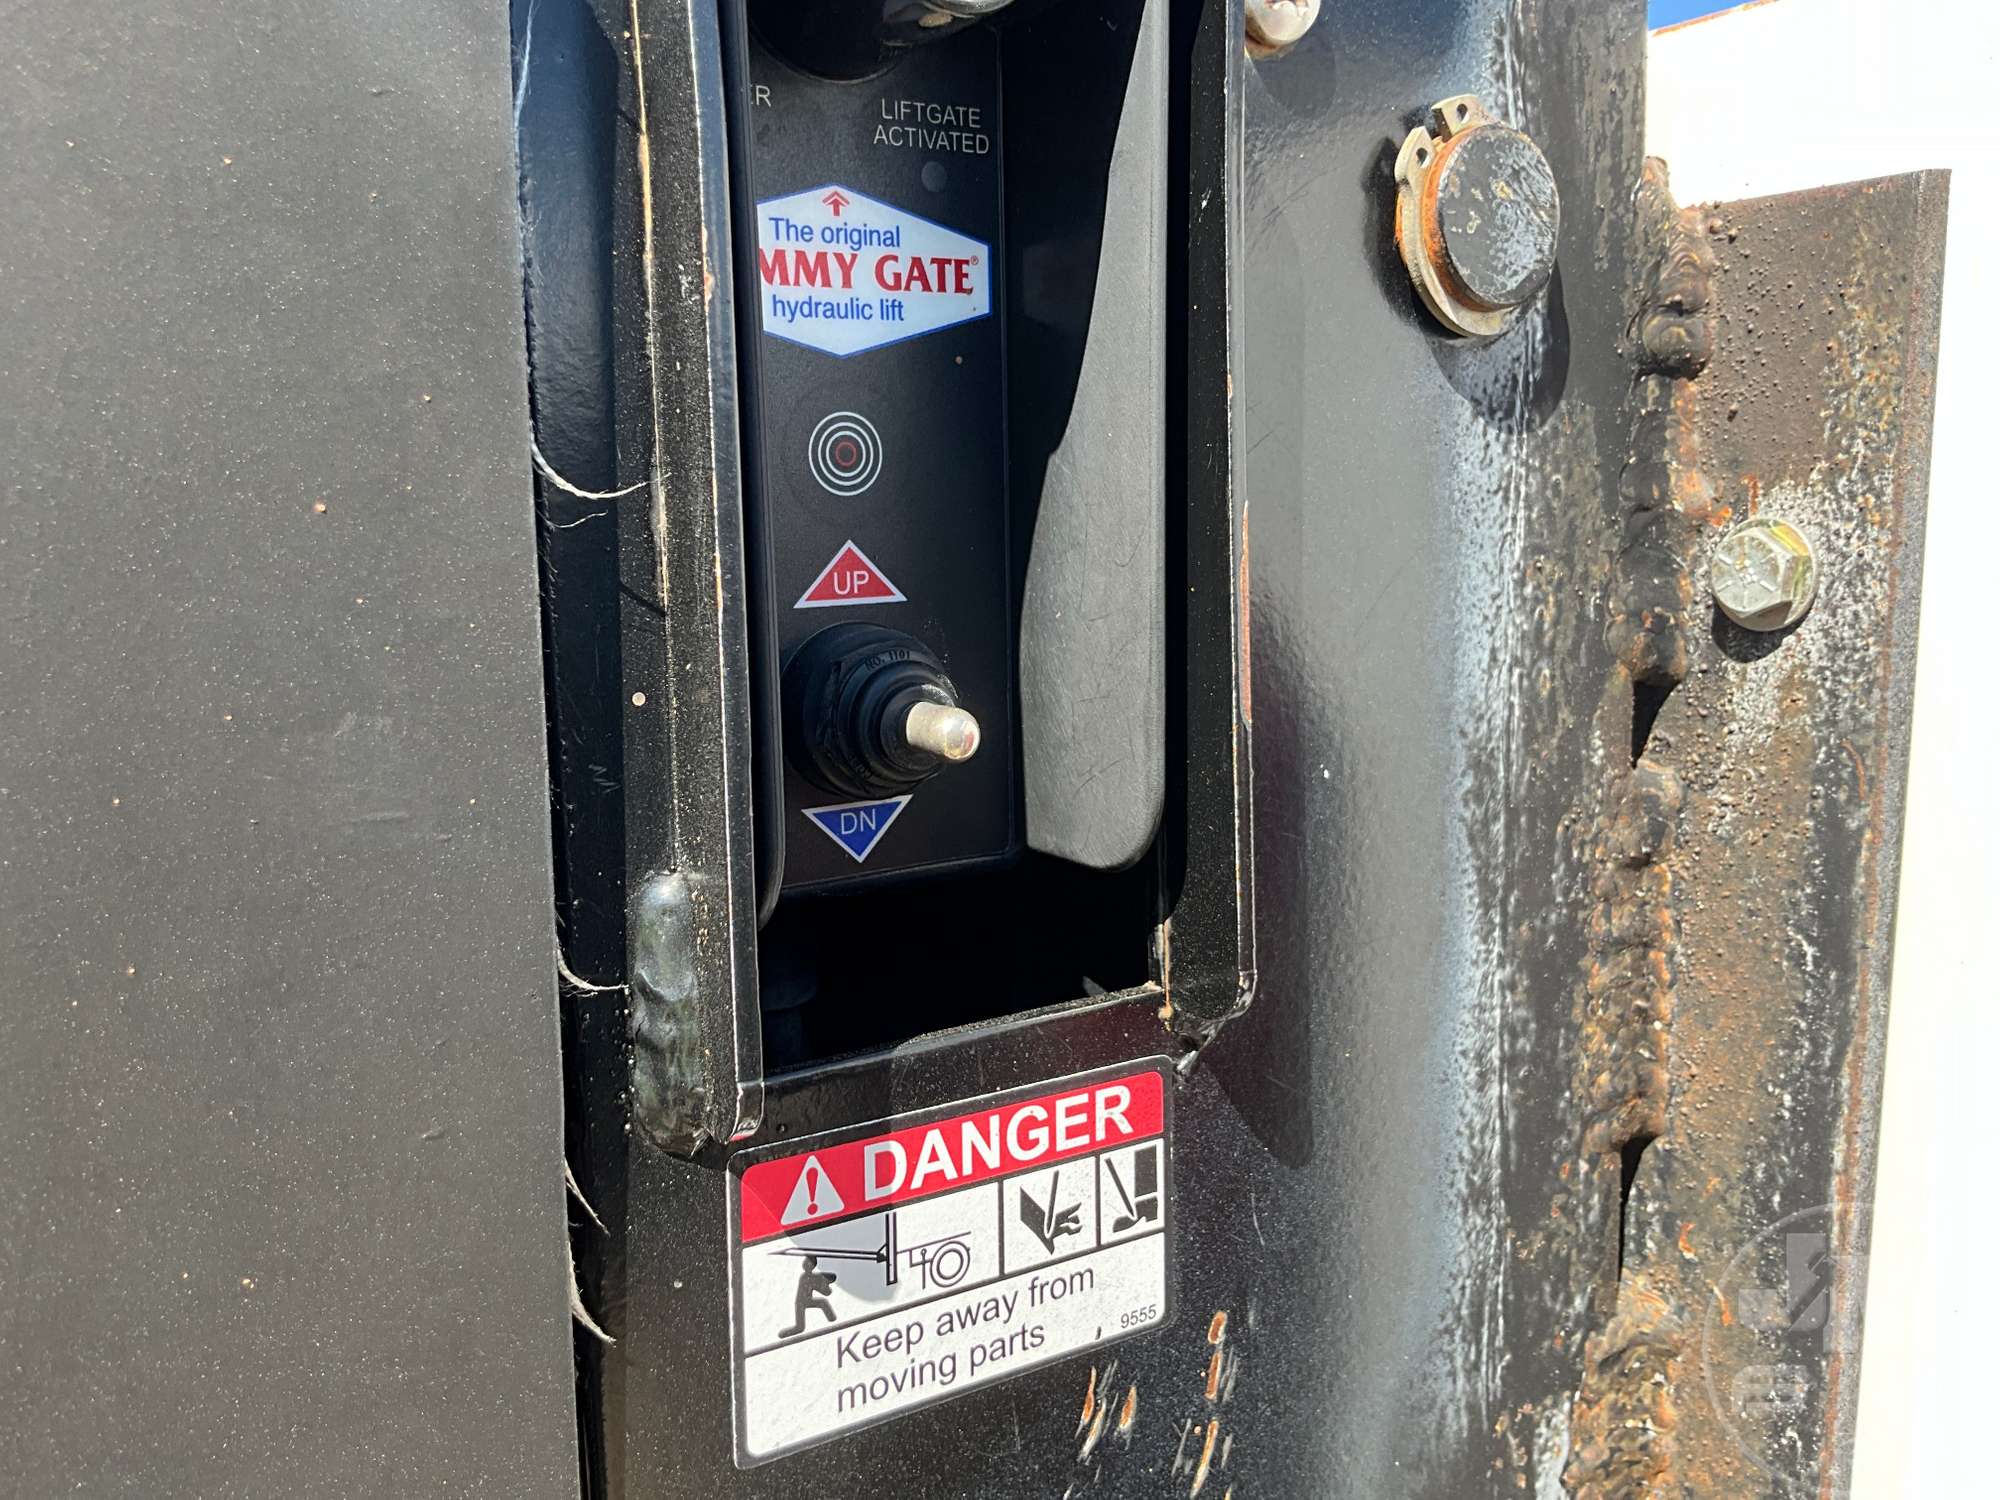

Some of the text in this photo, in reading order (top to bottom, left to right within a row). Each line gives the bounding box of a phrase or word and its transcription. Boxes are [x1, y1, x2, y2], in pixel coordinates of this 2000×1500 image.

[881, 98, 982, 129] LIFTGATE
[873, 124, 990, 155] ACTIVATED
[768, 216, 901, 251] The original
[772, 294, 905, 323] hydraulic lift
[832, 570, 870, 595] UP
[840, 808, 877, 835] DN
[863, 1085, 1134, 1201] DANGER
[836, 1267, 1095, 1369] Keep away from
[1119, 1303, 1158, 1330] 9555
[837, 1322, 1045, 1413] moving parts
